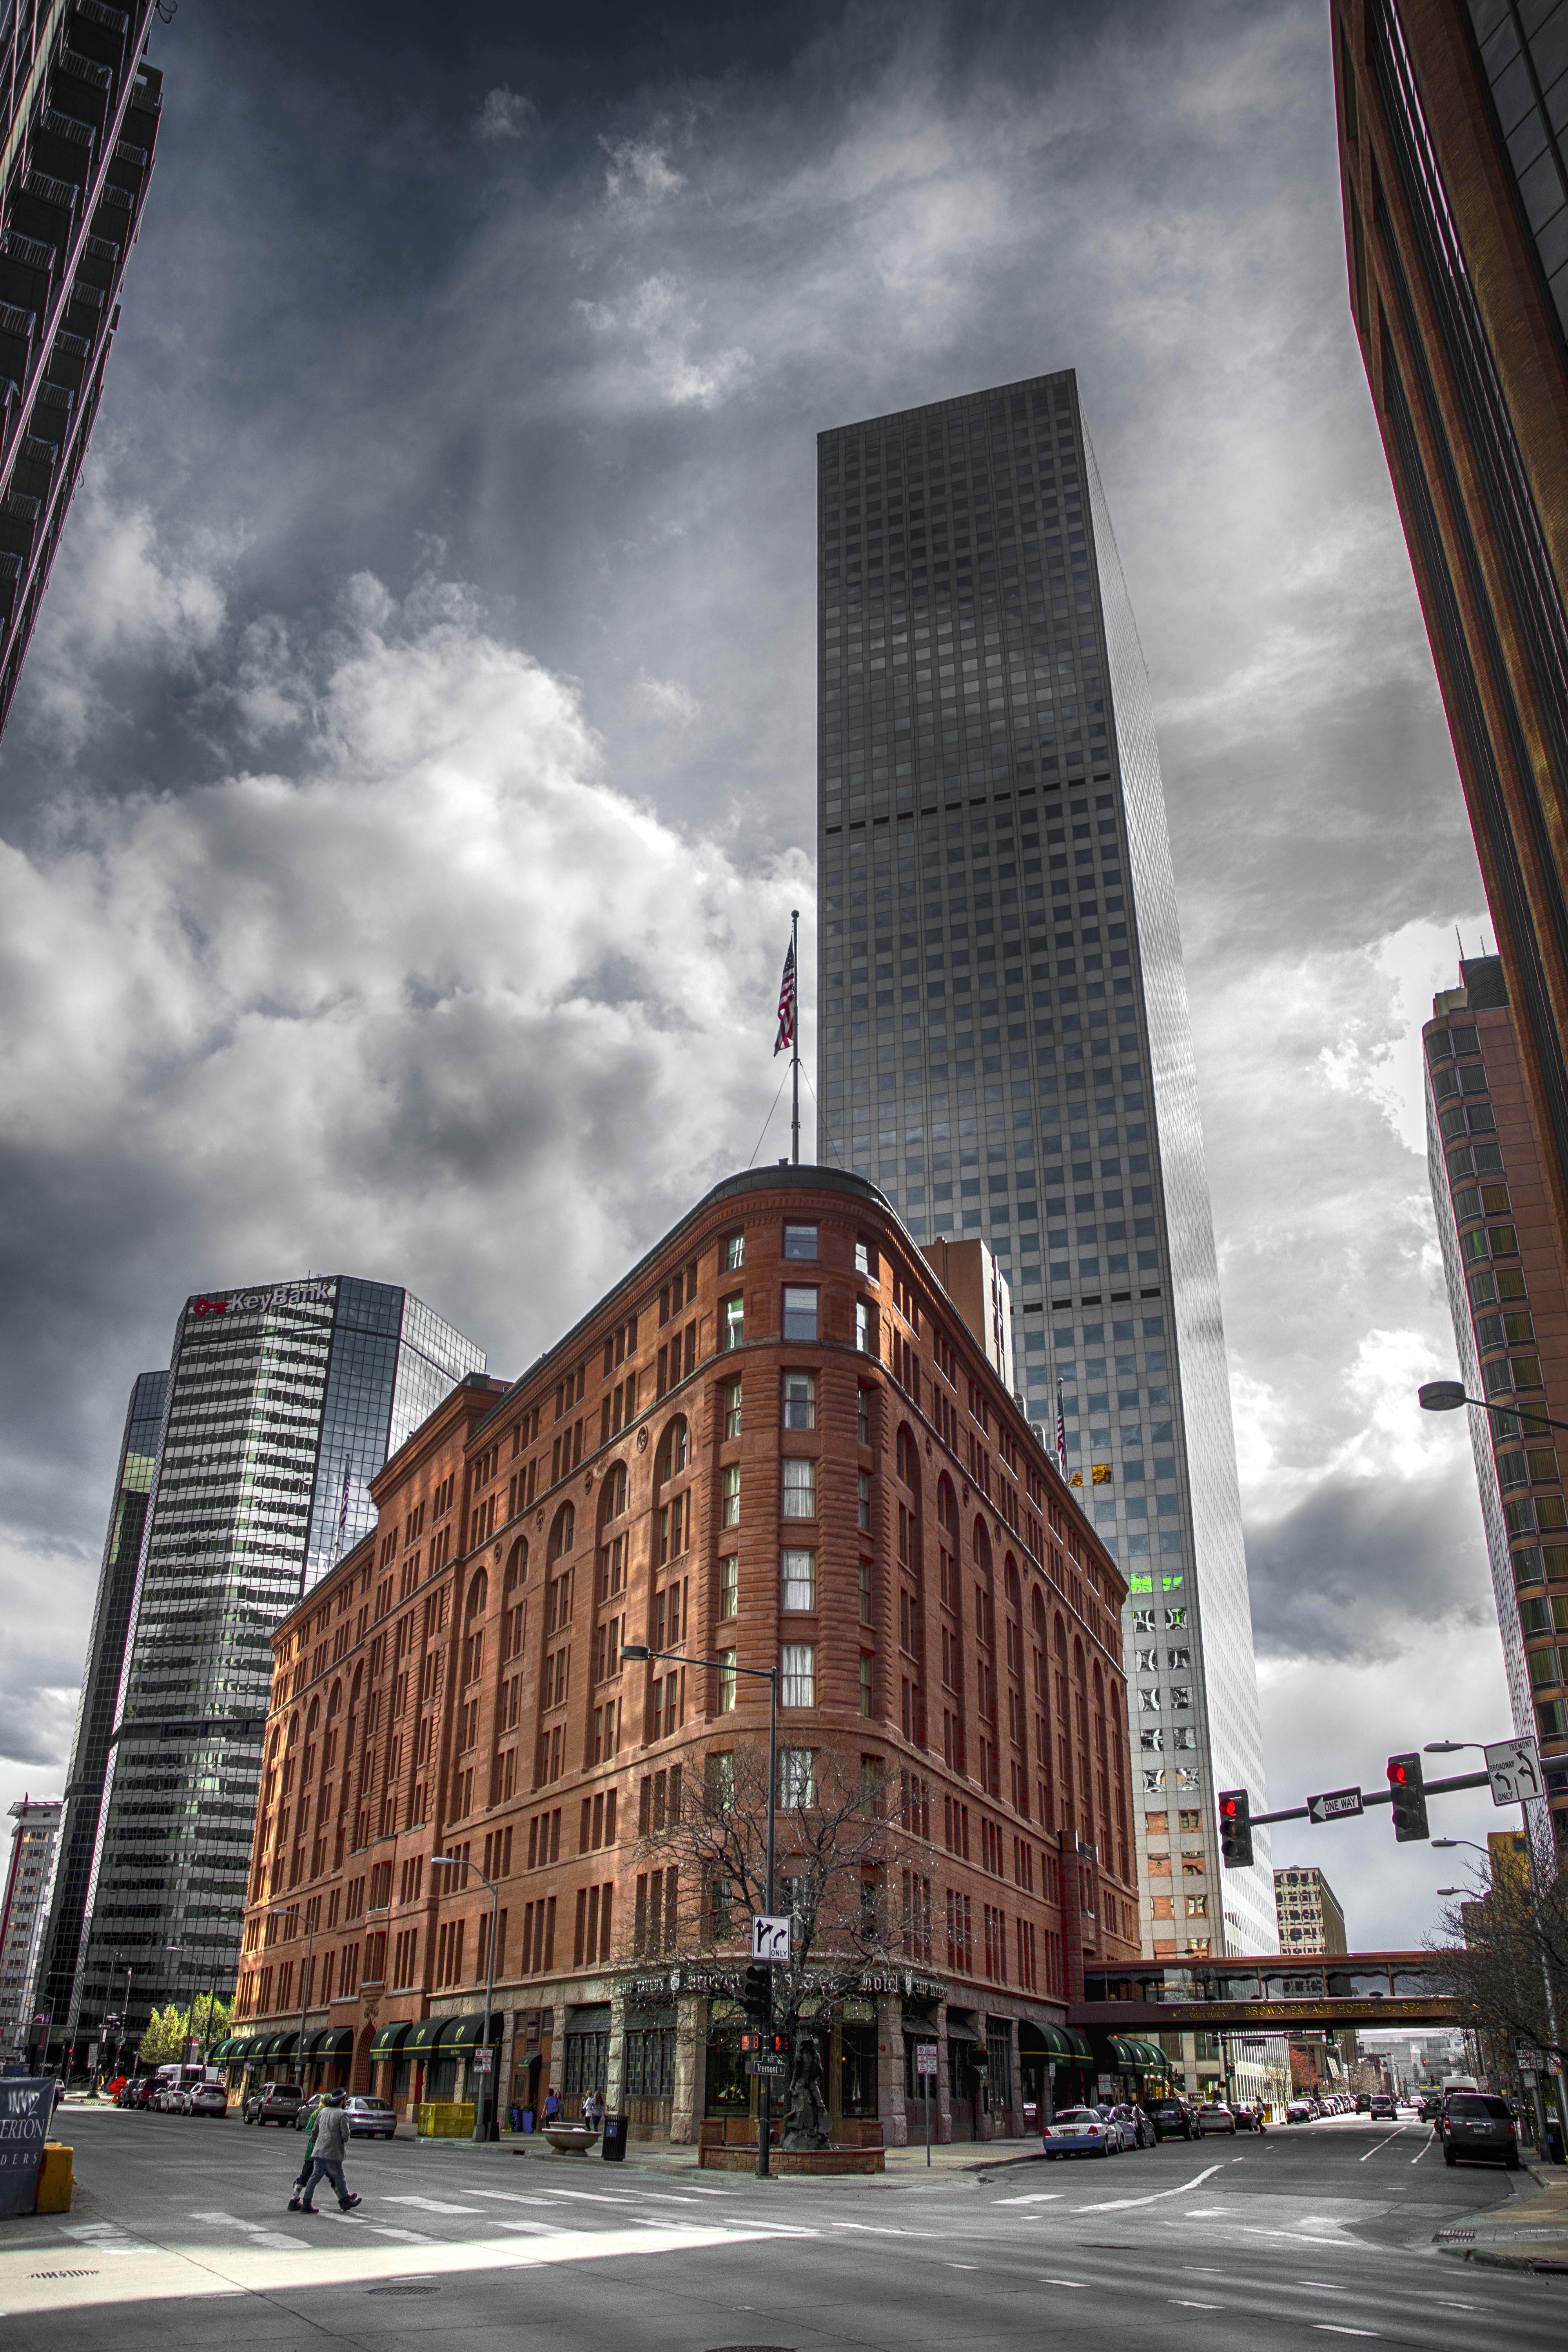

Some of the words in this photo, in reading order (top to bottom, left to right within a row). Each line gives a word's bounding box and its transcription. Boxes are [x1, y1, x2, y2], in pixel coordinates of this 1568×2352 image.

[231, 1282, 331, 1313] KeyBank
[1508, 1740, 1532, 1751] TREMONT
[1489, 1760, 1514, 1772] BROADWAY
[1497, 1791, 1513, 1801] ONLY
[1324, 1800, 1339, 1812] ONE
[1340, 1796, 1356, 1809] WAY
[916, 1981, 928, 1994] SHIP
[930, 1984, 948, 1999] TAVERN
[1243, 2005, 1285, 2016] BROWN
[1290, 2005, 1332, 2014] PALACE
[1337, 2004, 1374, 2013] HOTEL
[1402, 2003, 1423, 2012] SPA
[757, 2063, 778, 2073] Tremont
[0, 2119, 45, 2138] ERTON
